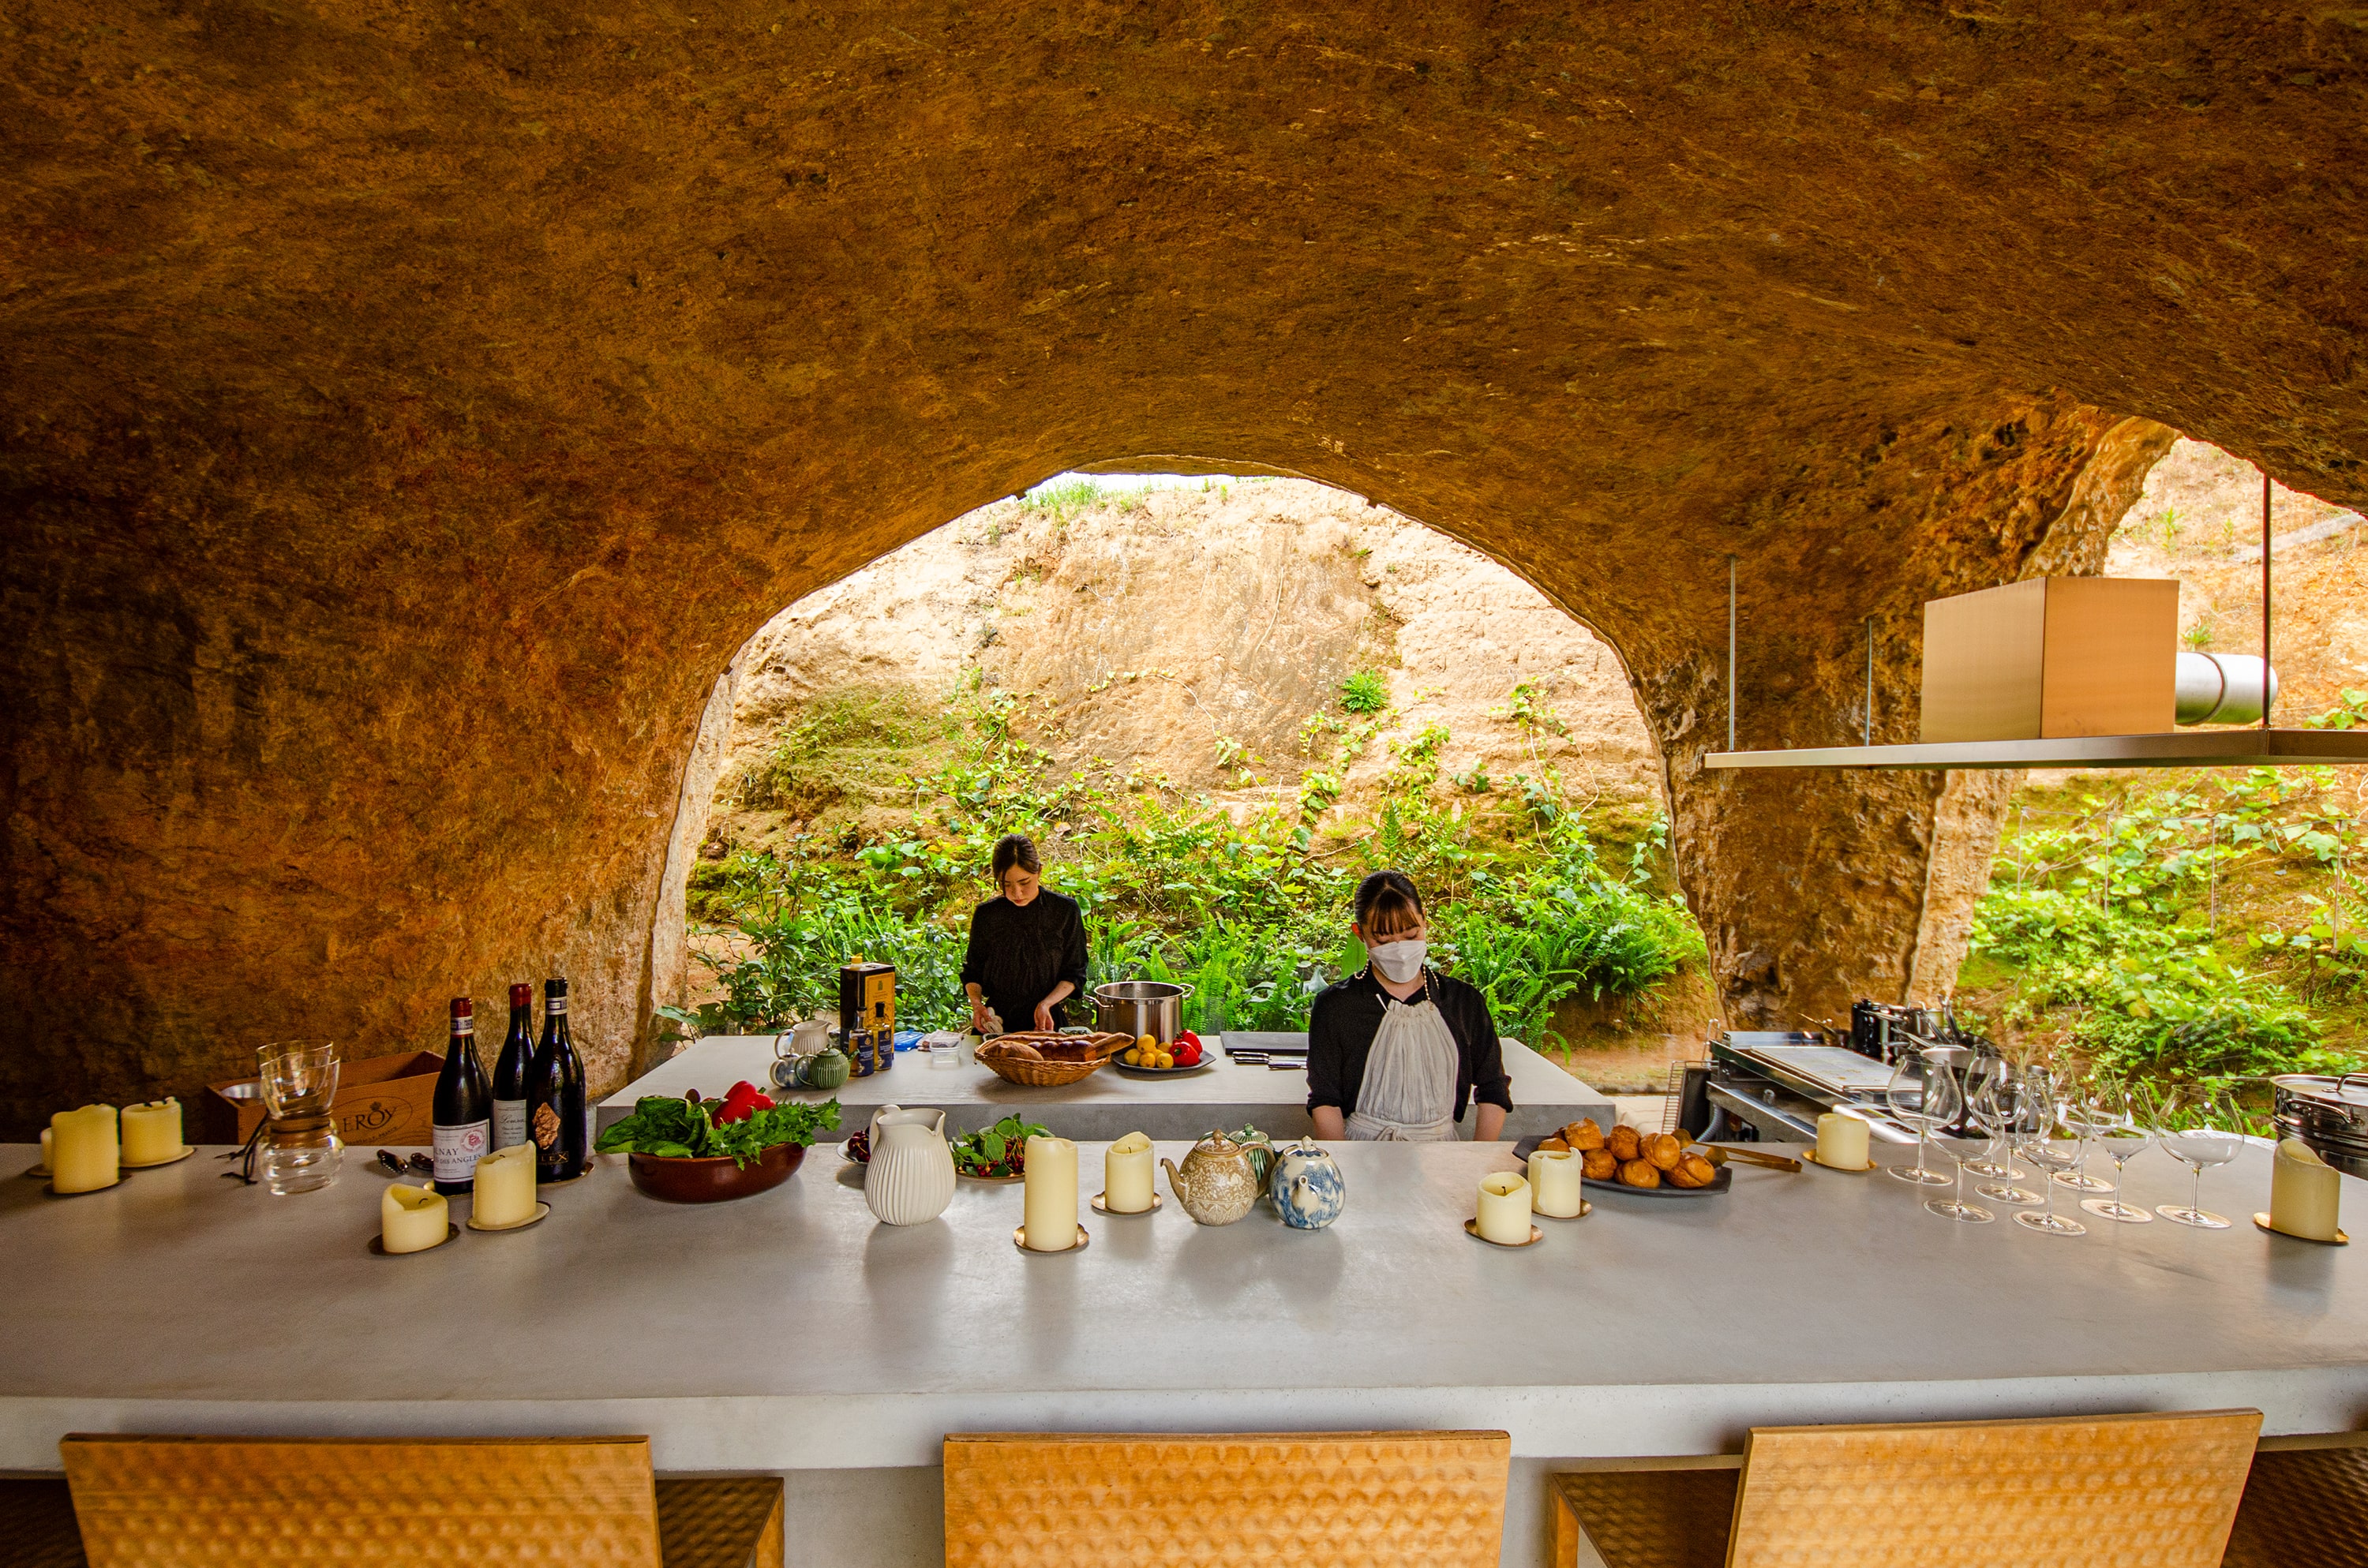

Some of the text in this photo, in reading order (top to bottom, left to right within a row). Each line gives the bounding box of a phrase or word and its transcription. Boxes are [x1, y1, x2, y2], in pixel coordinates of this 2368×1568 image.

[339, 1106, 397, 1133] EROY
[434, 1147, 459, 1156] LNAY
[537, 1151, 568, 1162] LEX
